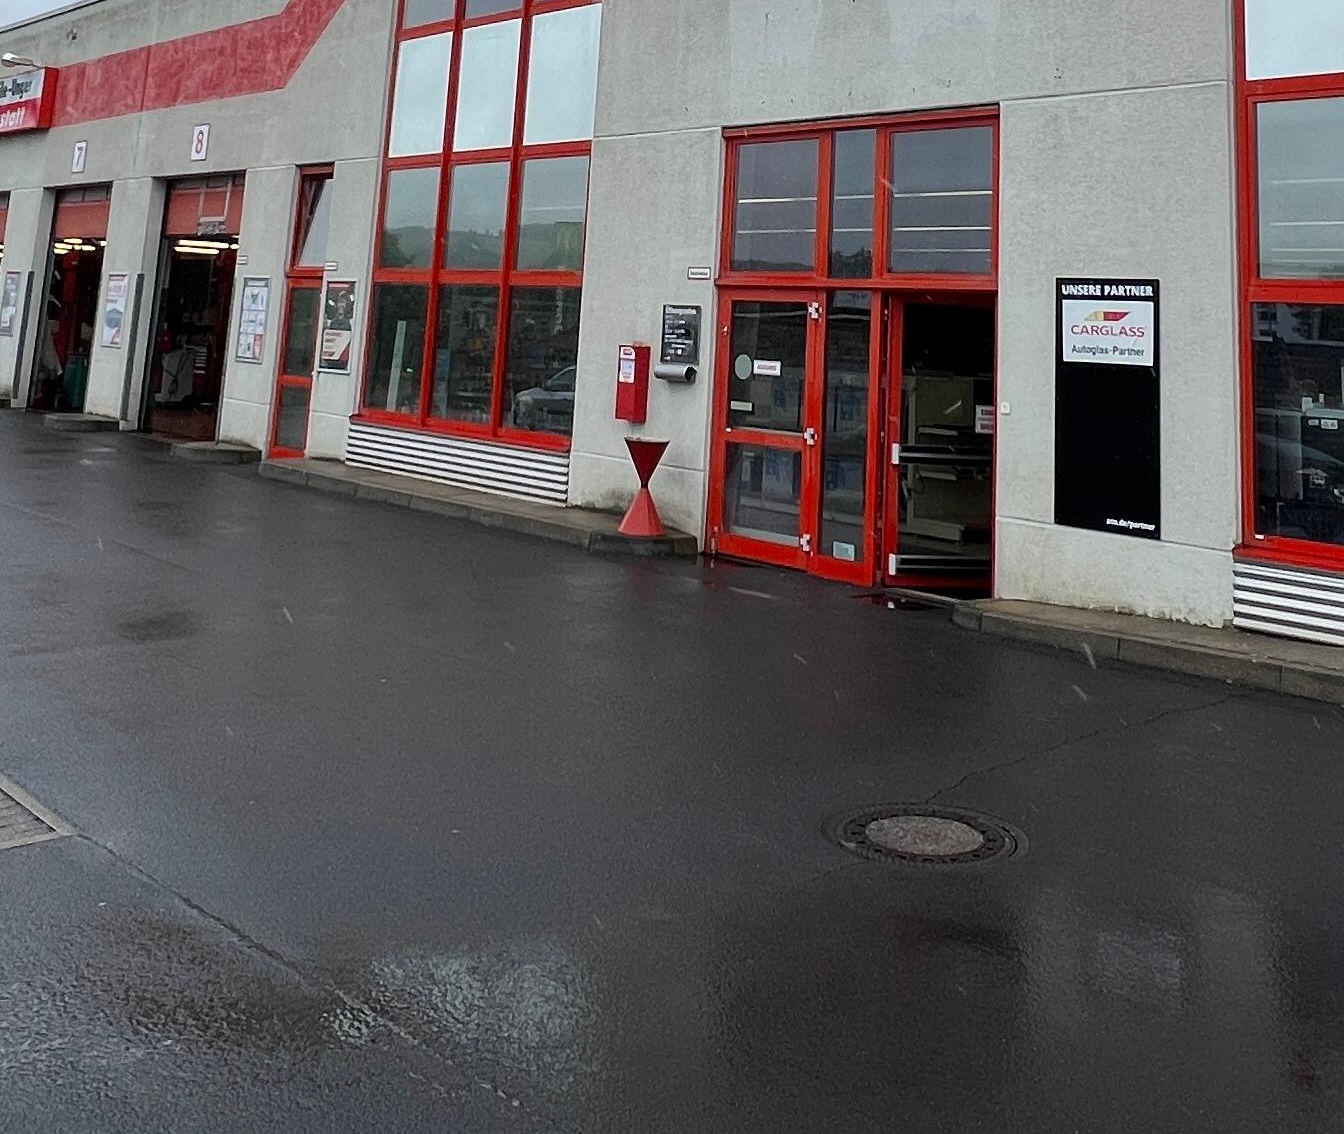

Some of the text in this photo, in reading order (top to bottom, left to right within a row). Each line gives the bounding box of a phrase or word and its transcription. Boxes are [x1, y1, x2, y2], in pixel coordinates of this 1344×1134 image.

[195, 130, 205, 155] 8
[1061, 284, 1154, 297] UNSERE PARTNER
[1070, 324, 1145, 338] CARGLASS
[1071, 344, 1144, 357] Autoglas-Partner
